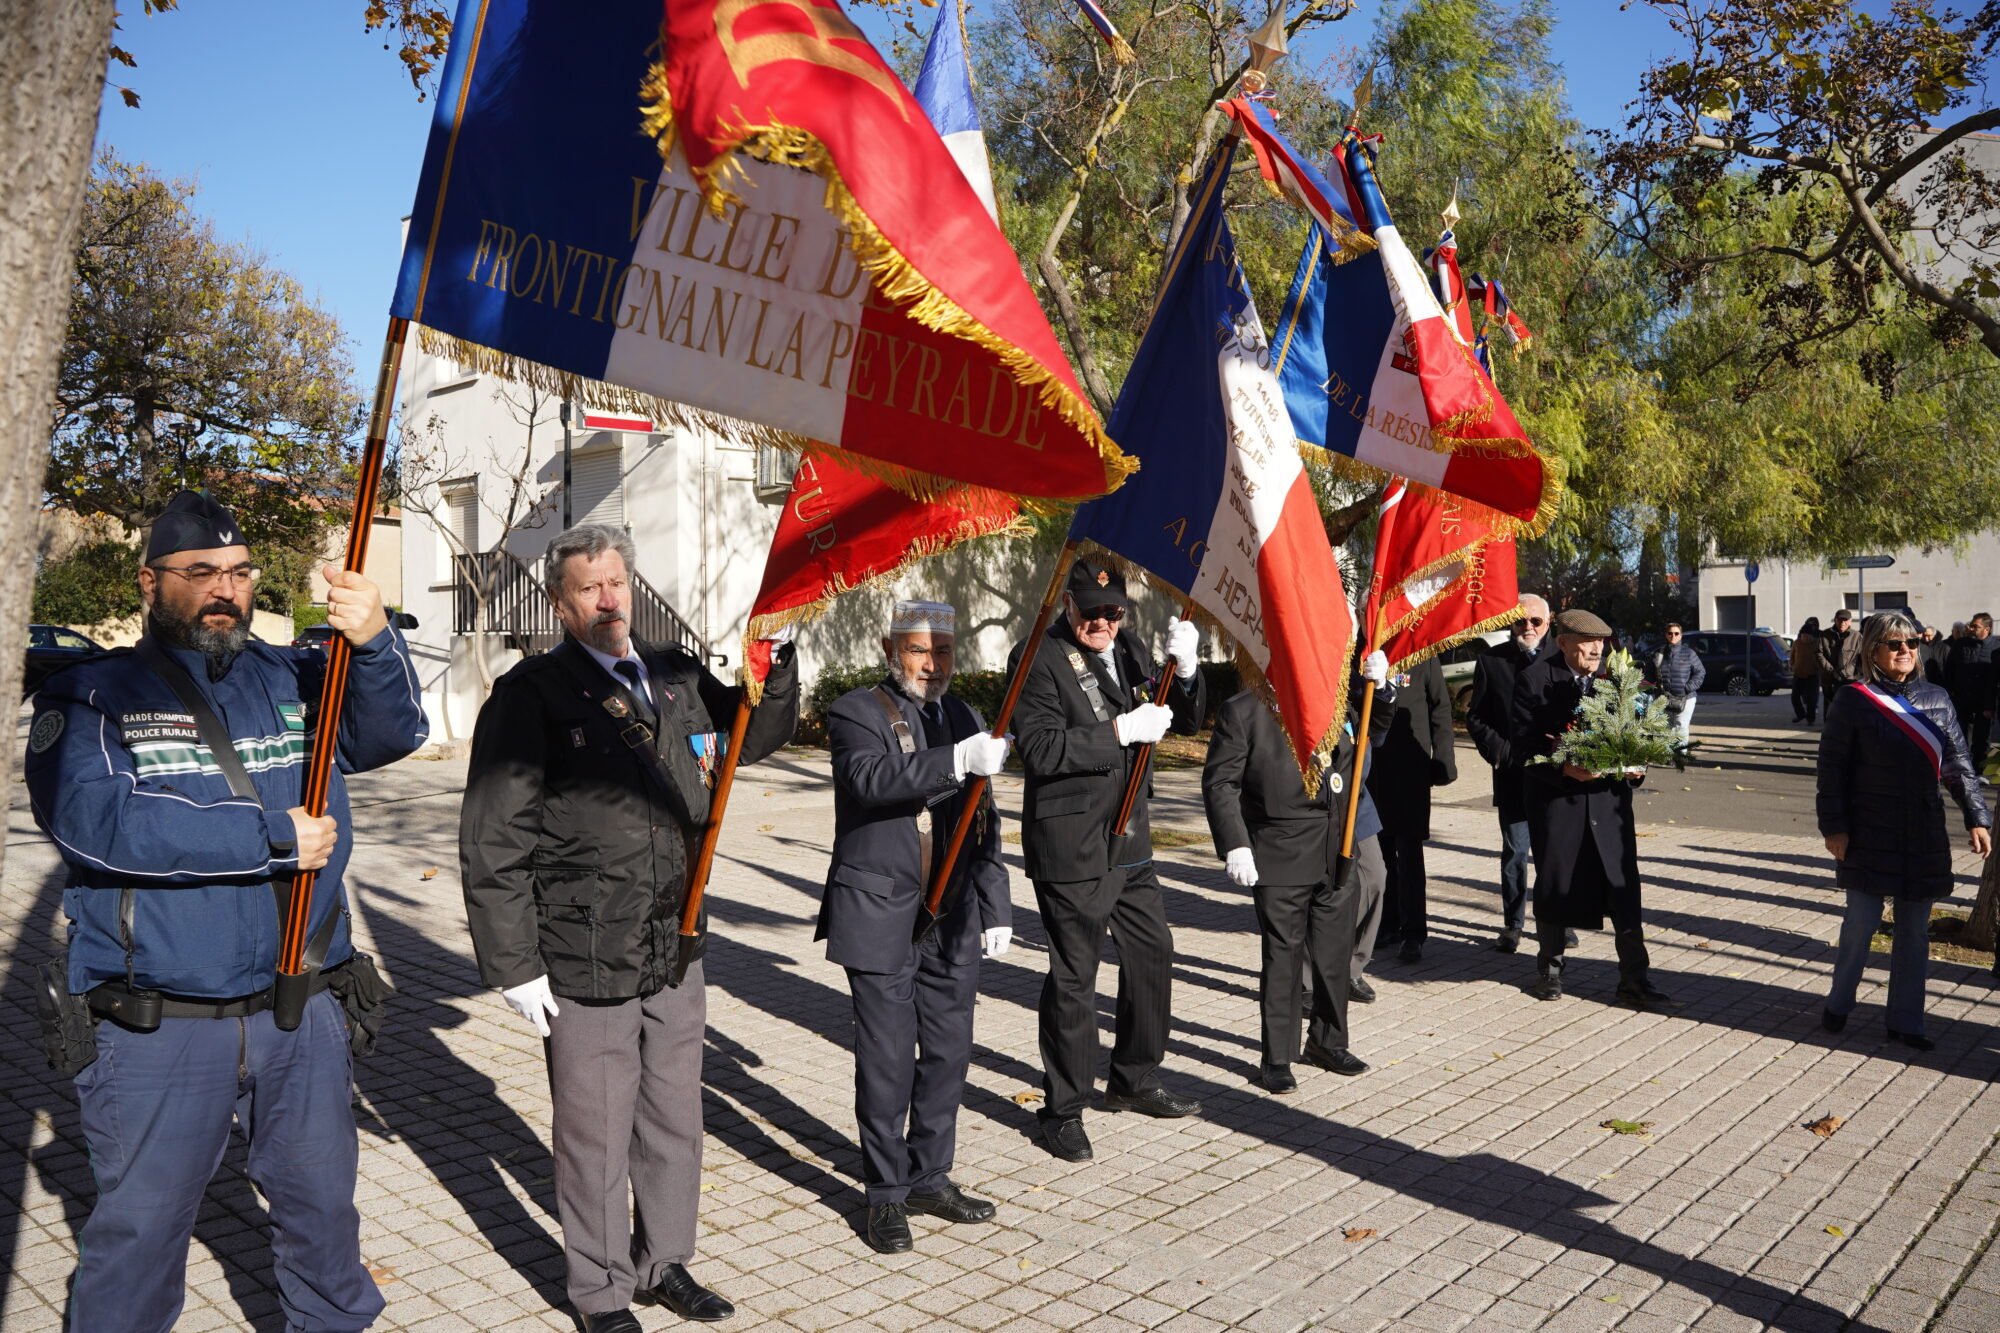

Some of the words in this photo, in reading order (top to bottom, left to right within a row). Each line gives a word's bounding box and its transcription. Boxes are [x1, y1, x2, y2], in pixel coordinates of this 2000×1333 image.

[629, 176, 800, 283] VILLE
[817, 228, 895, 313] D
[466, 219, 742, 358] FRONTIGNAN
[745, 299, 805, 382] LA
[819, 320, 1047, 451] PEYRADE
[1233, 386, 1276, 456] TUNISIE
[1318, 371, 1351, 407] DE
[1349, 394, 1379, 429] LA
[123, 713, 152, 723] GARDE
[153, 712, 196, 724] CHAMPETRE
[124, 728, 161, 739] POLICE
[162, 728, 199, 739] RURALE
